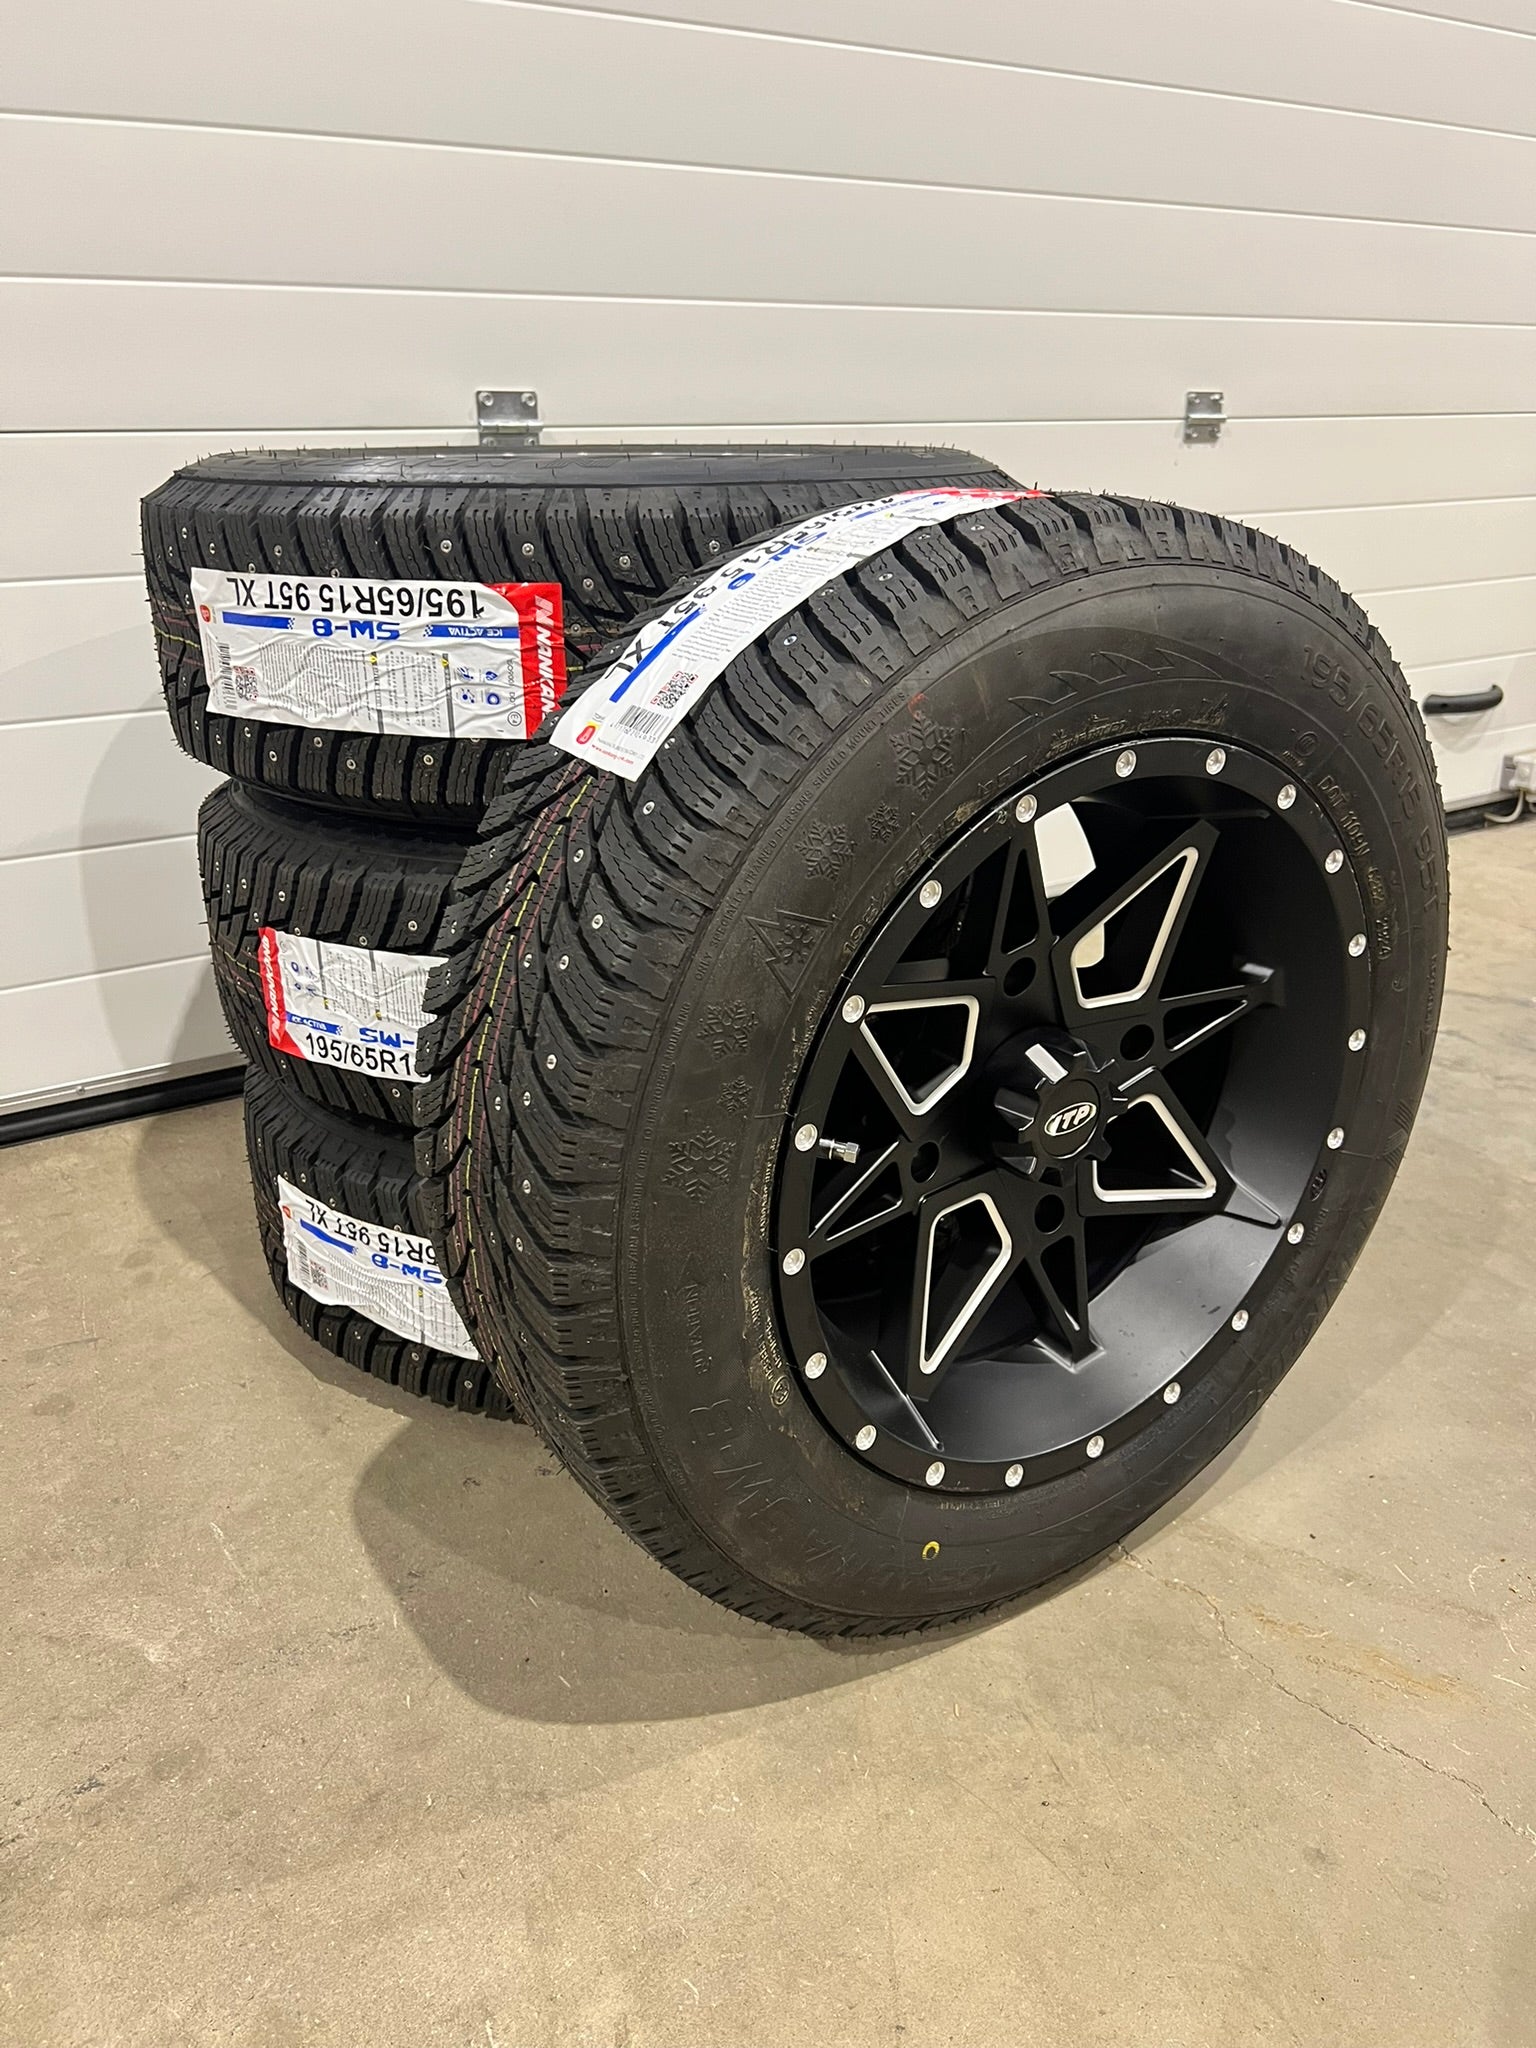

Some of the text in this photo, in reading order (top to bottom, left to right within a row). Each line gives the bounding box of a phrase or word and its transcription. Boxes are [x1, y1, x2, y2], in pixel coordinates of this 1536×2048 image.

[226, 577, 485, 618] 195/65R15 95T XL
[658, 586, 715, 633] 95T
[313, 618, 400, 641] SW-8
[447, 625, 504, 637] ICE ACTIVA
[535, 628, 558, 720] NANKAN
[605, 638, 653, 680] XL
[708, 886, 747, 948] SPECIALLY
[742, 837, 777, 886] TRAINED
[774, 788, 813, 839] PERSONS
[811, 748, 846, 790] SHOULD
[845, 716, 878, 751] MOUNT
[663, 1001, 692, 1059] MOUNTING
[306, 1032, 430, 1077] 195/65R1
[1047, 1103, 1094, 1136] ITP
[334, 1221, 371, 1246] 95T
[371, 1253, 443, 1284] SW-8
